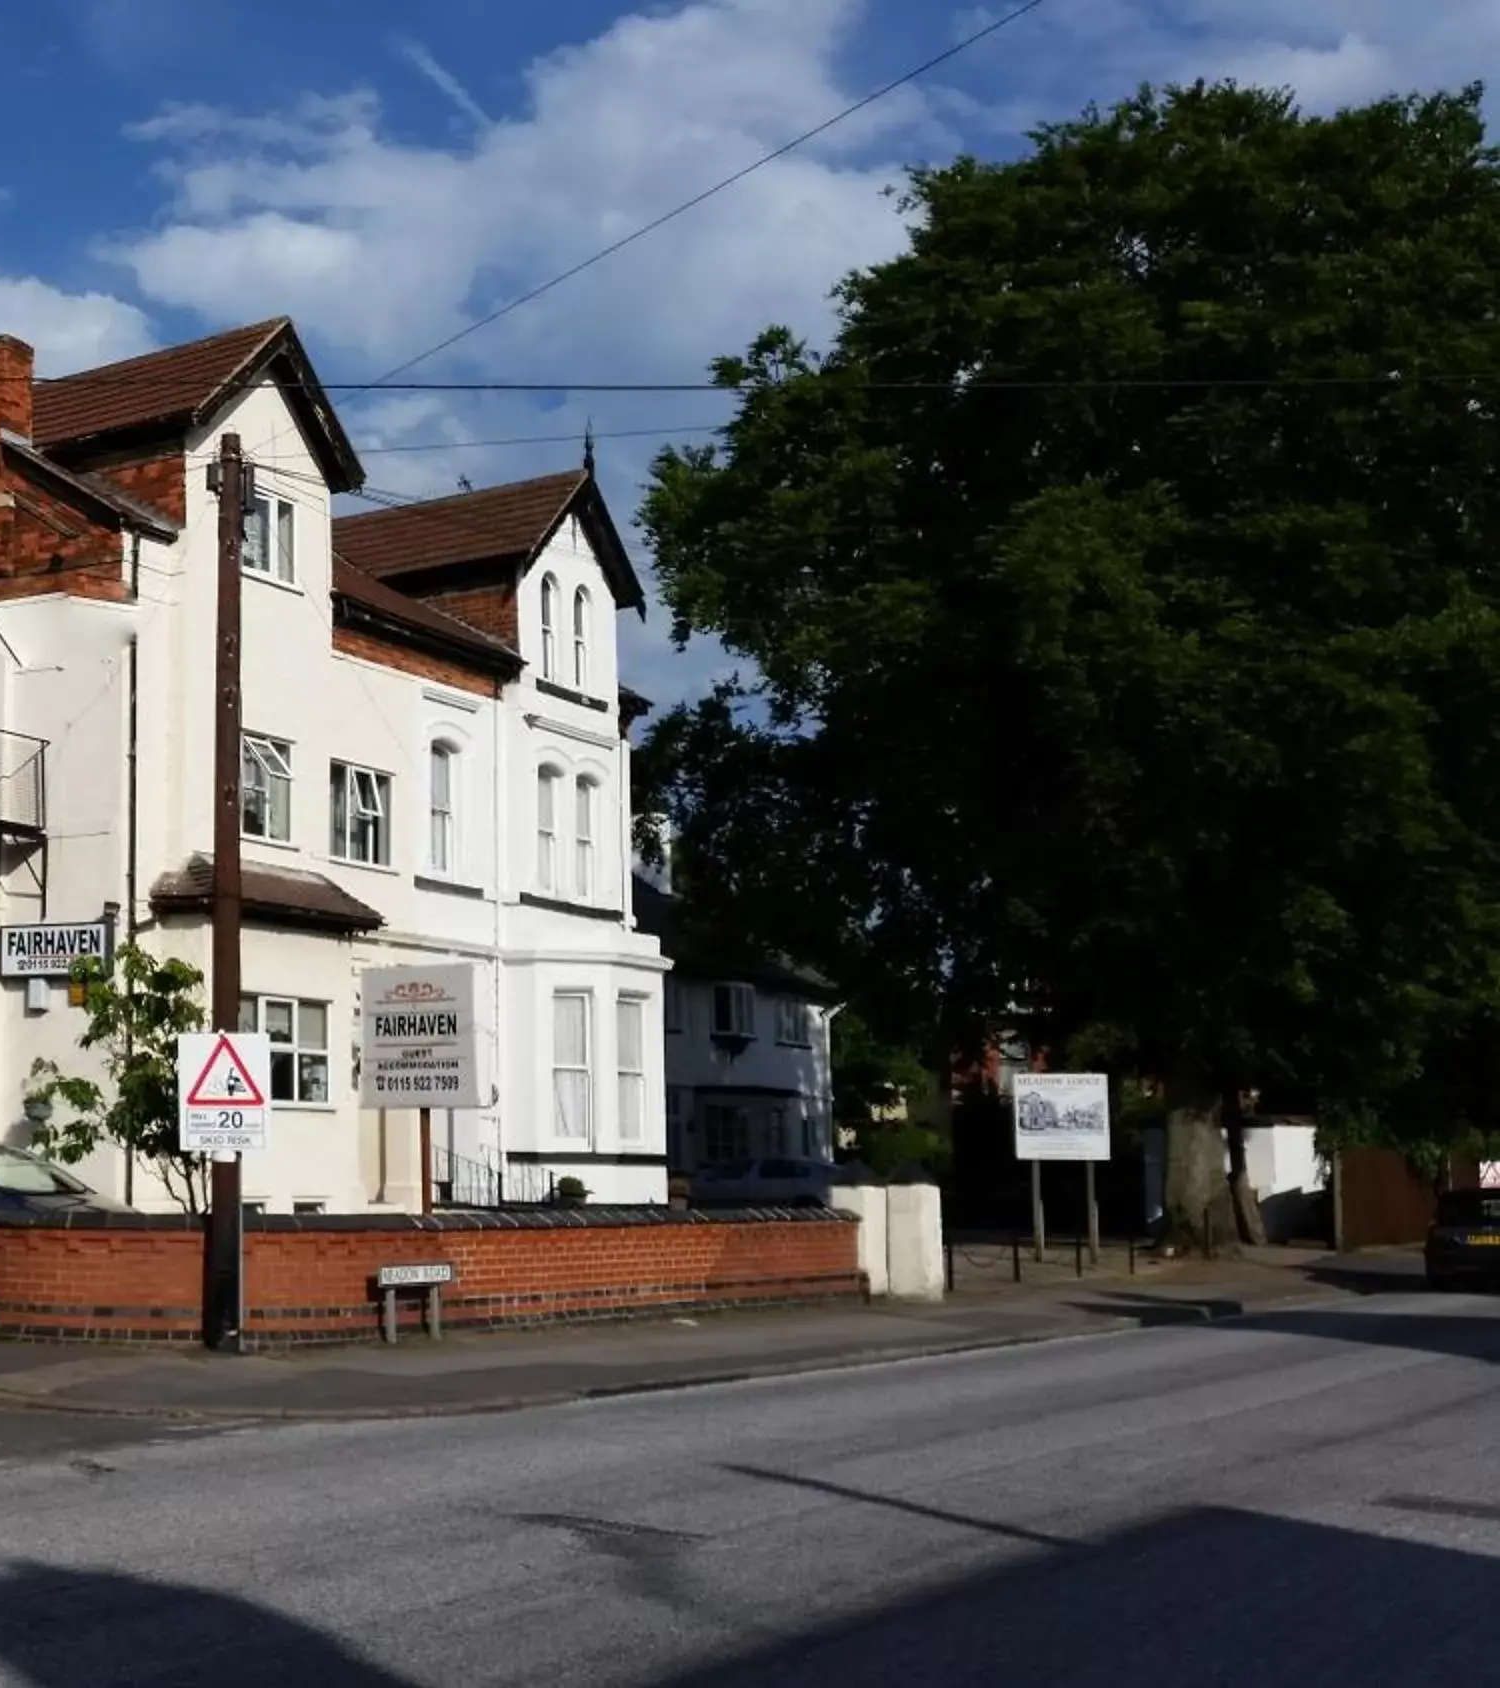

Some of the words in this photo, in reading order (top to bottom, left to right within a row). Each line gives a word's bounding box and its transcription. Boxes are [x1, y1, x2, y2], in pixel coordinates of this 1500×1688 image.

[7, 929, 101, 956] FAIRHAVEN
[375, 1014, 457, 1037] FAIRHAVEN
[388, 1075, 411, 1091] 0115
[217, 1110, 243, 1129] 20
